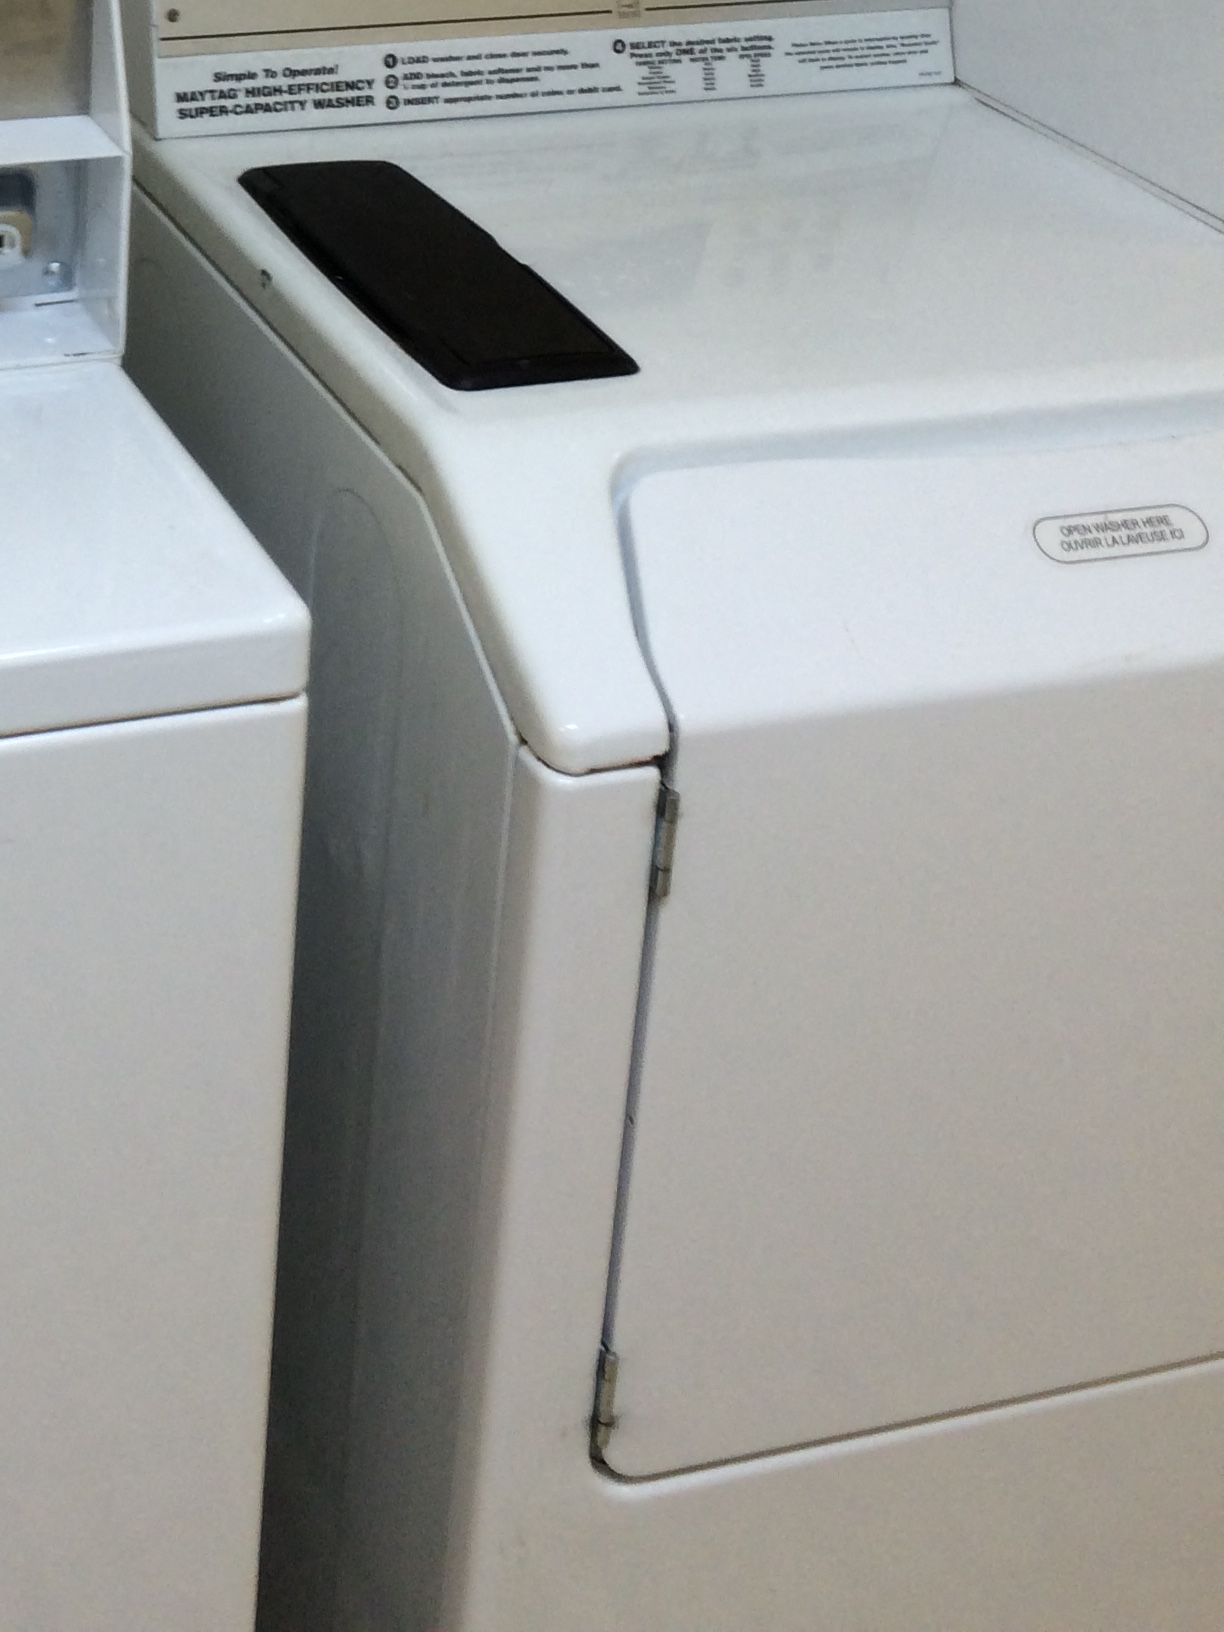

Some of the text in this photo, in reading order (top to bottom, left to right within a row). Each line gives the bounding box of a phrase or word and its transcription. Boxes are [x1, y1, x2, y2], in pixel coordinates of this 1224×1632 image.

[212, 64, 339, 84] Simple To Operate!
[243, 78, 376, 98] HIGH-EFFICIENCY
[176, 94, 376, 120] SUPER-CAPACITY WASHER
[1060, 514, 1174, 538] OPEN WASHER HERE
[1060, 536, 1104, 553] OUVRIR
[1106, 536, 1120, 548] LA
[1120, 529, 1169, 546] LAVEUSE
